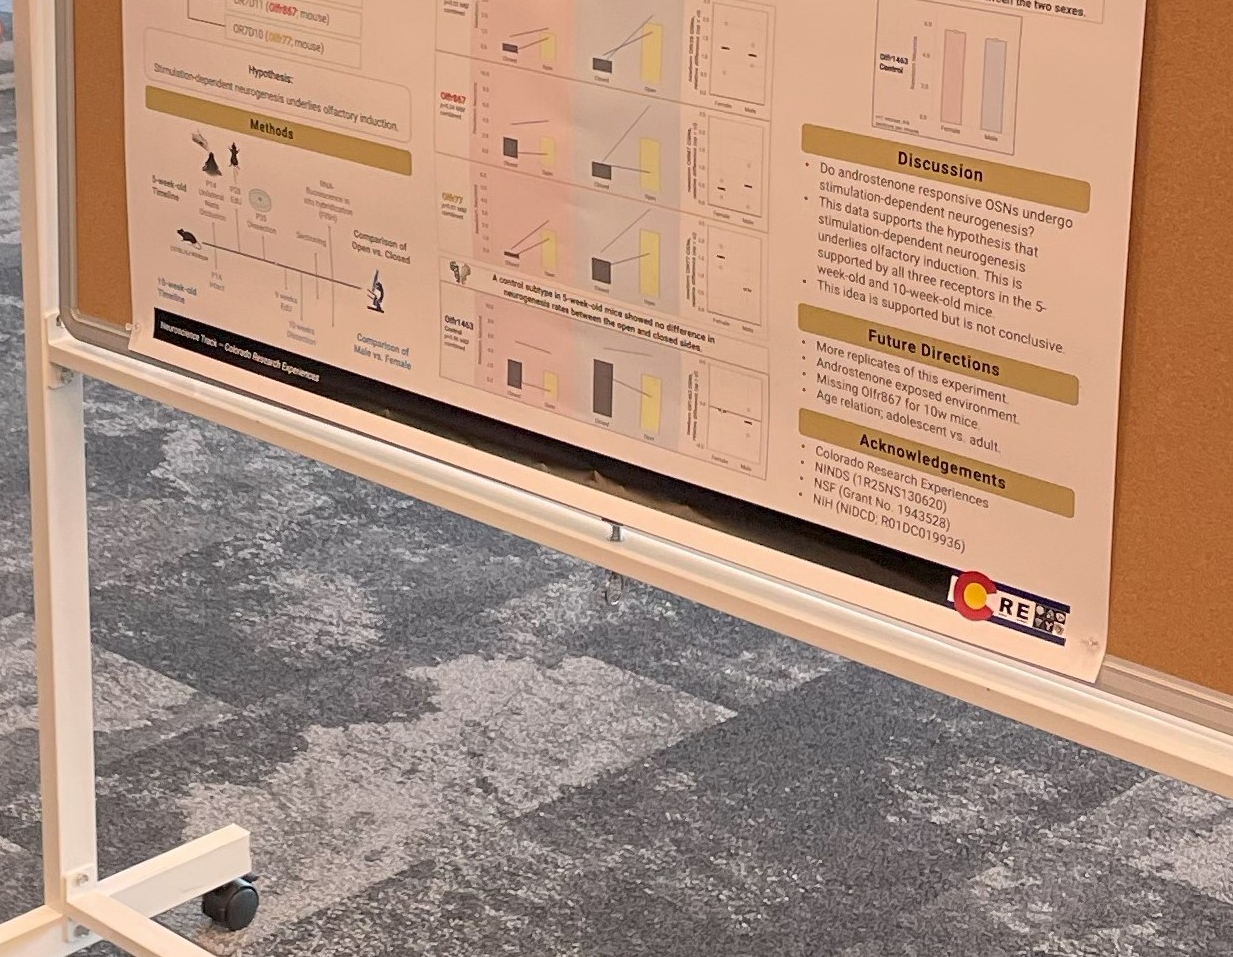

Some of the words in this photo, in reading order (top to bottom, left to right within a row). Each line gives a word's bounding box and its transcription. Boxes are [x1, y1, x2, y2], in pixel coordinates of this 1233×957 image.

[1033, 0, 1052, 11] two
[248, 65, 294, 84] Hypothesis:
[249, 118, 294, 139] Methods
[897, 150, 983, 182] Discussion
[819, 181, 944, 218] stimulation-dependent
[947, 210, 1035, 236] neurogenesis?
[820, 161, 835, 175] Do
[837, 168, 915, 193] androstenone
[918, 185, 982, 208] responsive
[985, 198, 1018, 216] OSNs
[1022, 209, 1073, 229] undergo
[818, 215, 942, 253] stimulation-dependent
[946, 245, 1026, 272] neurogenesis
[819, 195, 842, 211] This
[844, 202, 869, 218] data
[872, 210, 922, 230] supports
[925, 220, 944, 235] the
[946, 224, 1011, 251] hypothesis
[1014, 241, 1038, 258] that
[817, 232, 867, 252] underlies
[870, 243, 920, 267] olfactory
[923, 255, 979, 279] induction.
[984, 269, 1008, 286] This
[1012, 276, 1022, 289] is
[817, 248, 872, 270] supported
[875, 260, 888, 276] by
[891, 265, 904, 278] all
[907, 269, 936, 286] three
[939, 279, 995, 300] receptors
[998, 291, 1009, 304] in
[1012, 295, 1031, 310] the
[1035, 300, 1046, 312] 5-
[817, 265, 865, 285] week-old
[868, 278, 889, 291] and
[893, 282, 960, 309] 10-week-old
[963, 302, 995, 317] mice.
[817, 279, 840, 295] This
[843, 287, 866, 302] idea
[868, 292, 878, 305] is
[881, 298, 938, 321] supported
[941, 310, 960, 326] but
[963, 317, 973, 330] is
[976, 323, 995, 336] not
[998, 329, 1065, 354] conclusive.
[816, 340, 844, 358] More
[847, 351, 900, 373] replicates
[903, 366, 914, 377] of
[917, 369, 938, 384] this
[941, 377, 1008, 404] experiment.
[868, 328, 916, 353] Future
[921, 343, 1000, 376] Directions
[816, 357, 892, 387] Androstenone
[894, 381, 942, 402] exposed
[944, 395, 1019, 424] environment.
[816, 372, 858, 396] Missing
[861, 385, 901, 406] Olfr867
[904, 397, 920, 412] for
[924, 404, 947, 419] 10w
[949, 413, 980, 429] mice.
[816, 388, 837, 404] Age
[840, 397, 883, 419] relation;
[885, 411, 946, 437] adolescent
[949, 430, 965, 441] vs.
[969, 436, 1000, 452] adult.
[814, 461, 850, 481] NINDS
[852, 472, 947, 514] (1R25NS130620)
[815, 445, 864, 469] Colorado
[866, 460, 917, 486] Research
[920, 477, 988, 508] Experiences
[859, 434, 1006, 489] Acknowledgements
[813, 493, 833, 509] NIH
[835, 500, 878, 525] (NIDCD;
[881, 514, 965, 554] R01DC019936)
[814, 477, 835, 492] NSF
[838, 484, 872, 505] (Grant
[875, 496, 894, 511] No.
[898, 504, 950, 532] 1943528)
